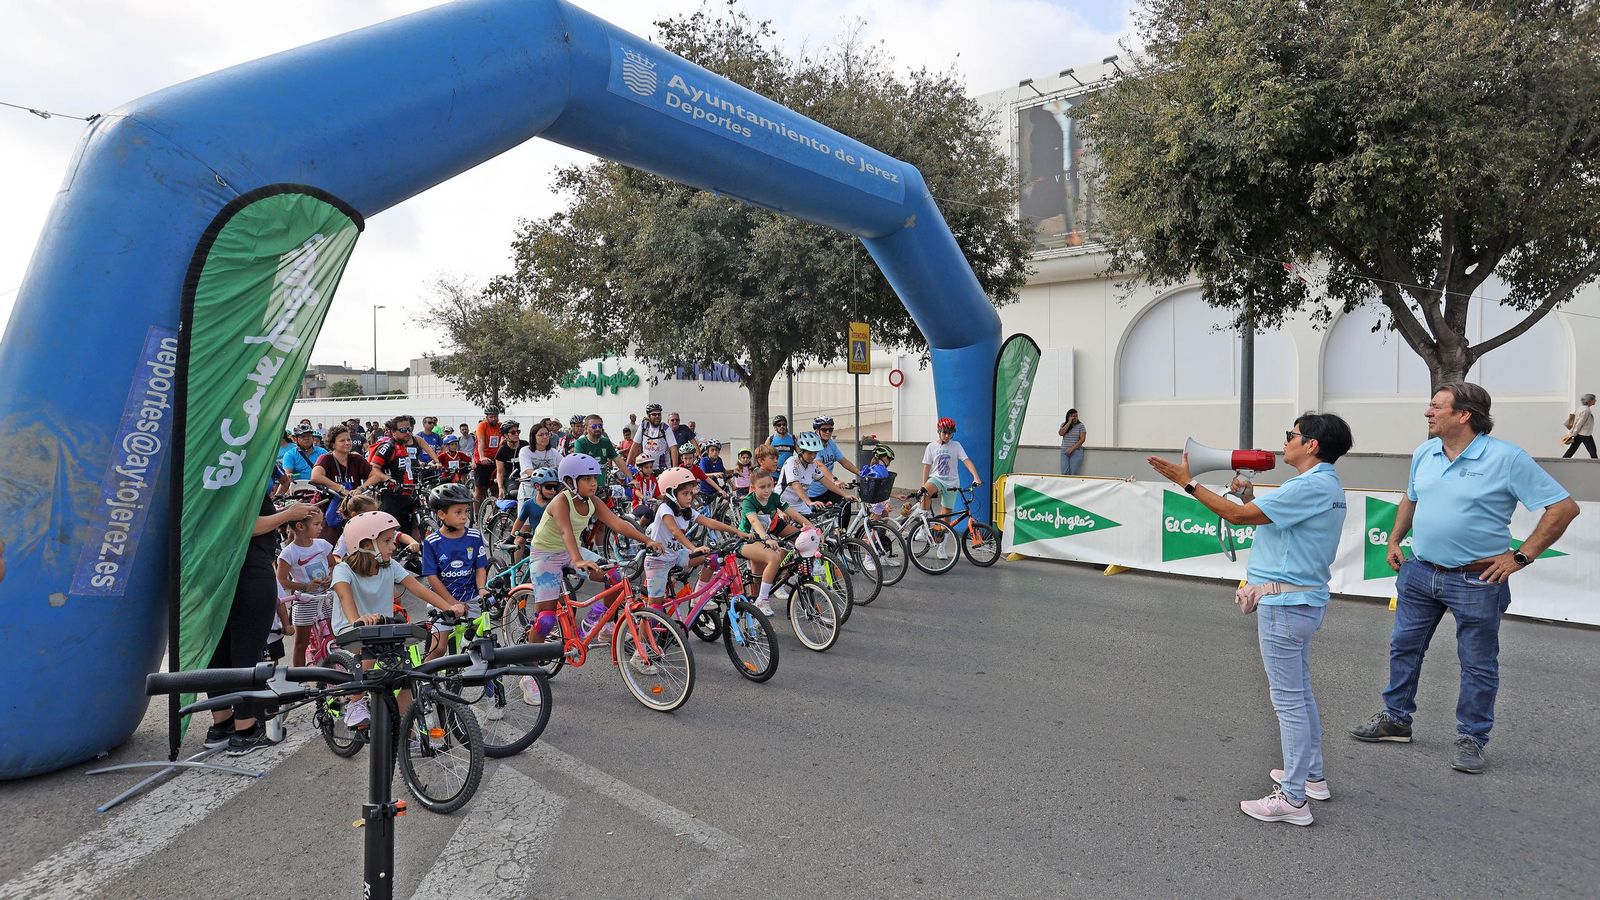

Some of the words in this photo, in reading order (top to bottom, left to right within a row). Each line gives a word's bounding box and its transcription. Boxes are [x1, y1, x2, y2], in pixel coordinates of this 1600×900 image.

[666, 92, 752, 138] Deportes
[668, 75, 830, 154] Ayuntamiento
[835, 149, 856, 165] de
[859, 157, 899, 183] Jerez
[595, 361, 640, 395] Inglés
[220, 356, 286, 446] Corte
[1016, 505, 1027, 520] El
[1028, 508, 1054, 523] Corte
[1054, 507, 1095, 530] Inglés
[1164, 516, 1180, 532] El
[1181, 518, 1217, 536] Corte
[1368, 527, 1388, 546] El
